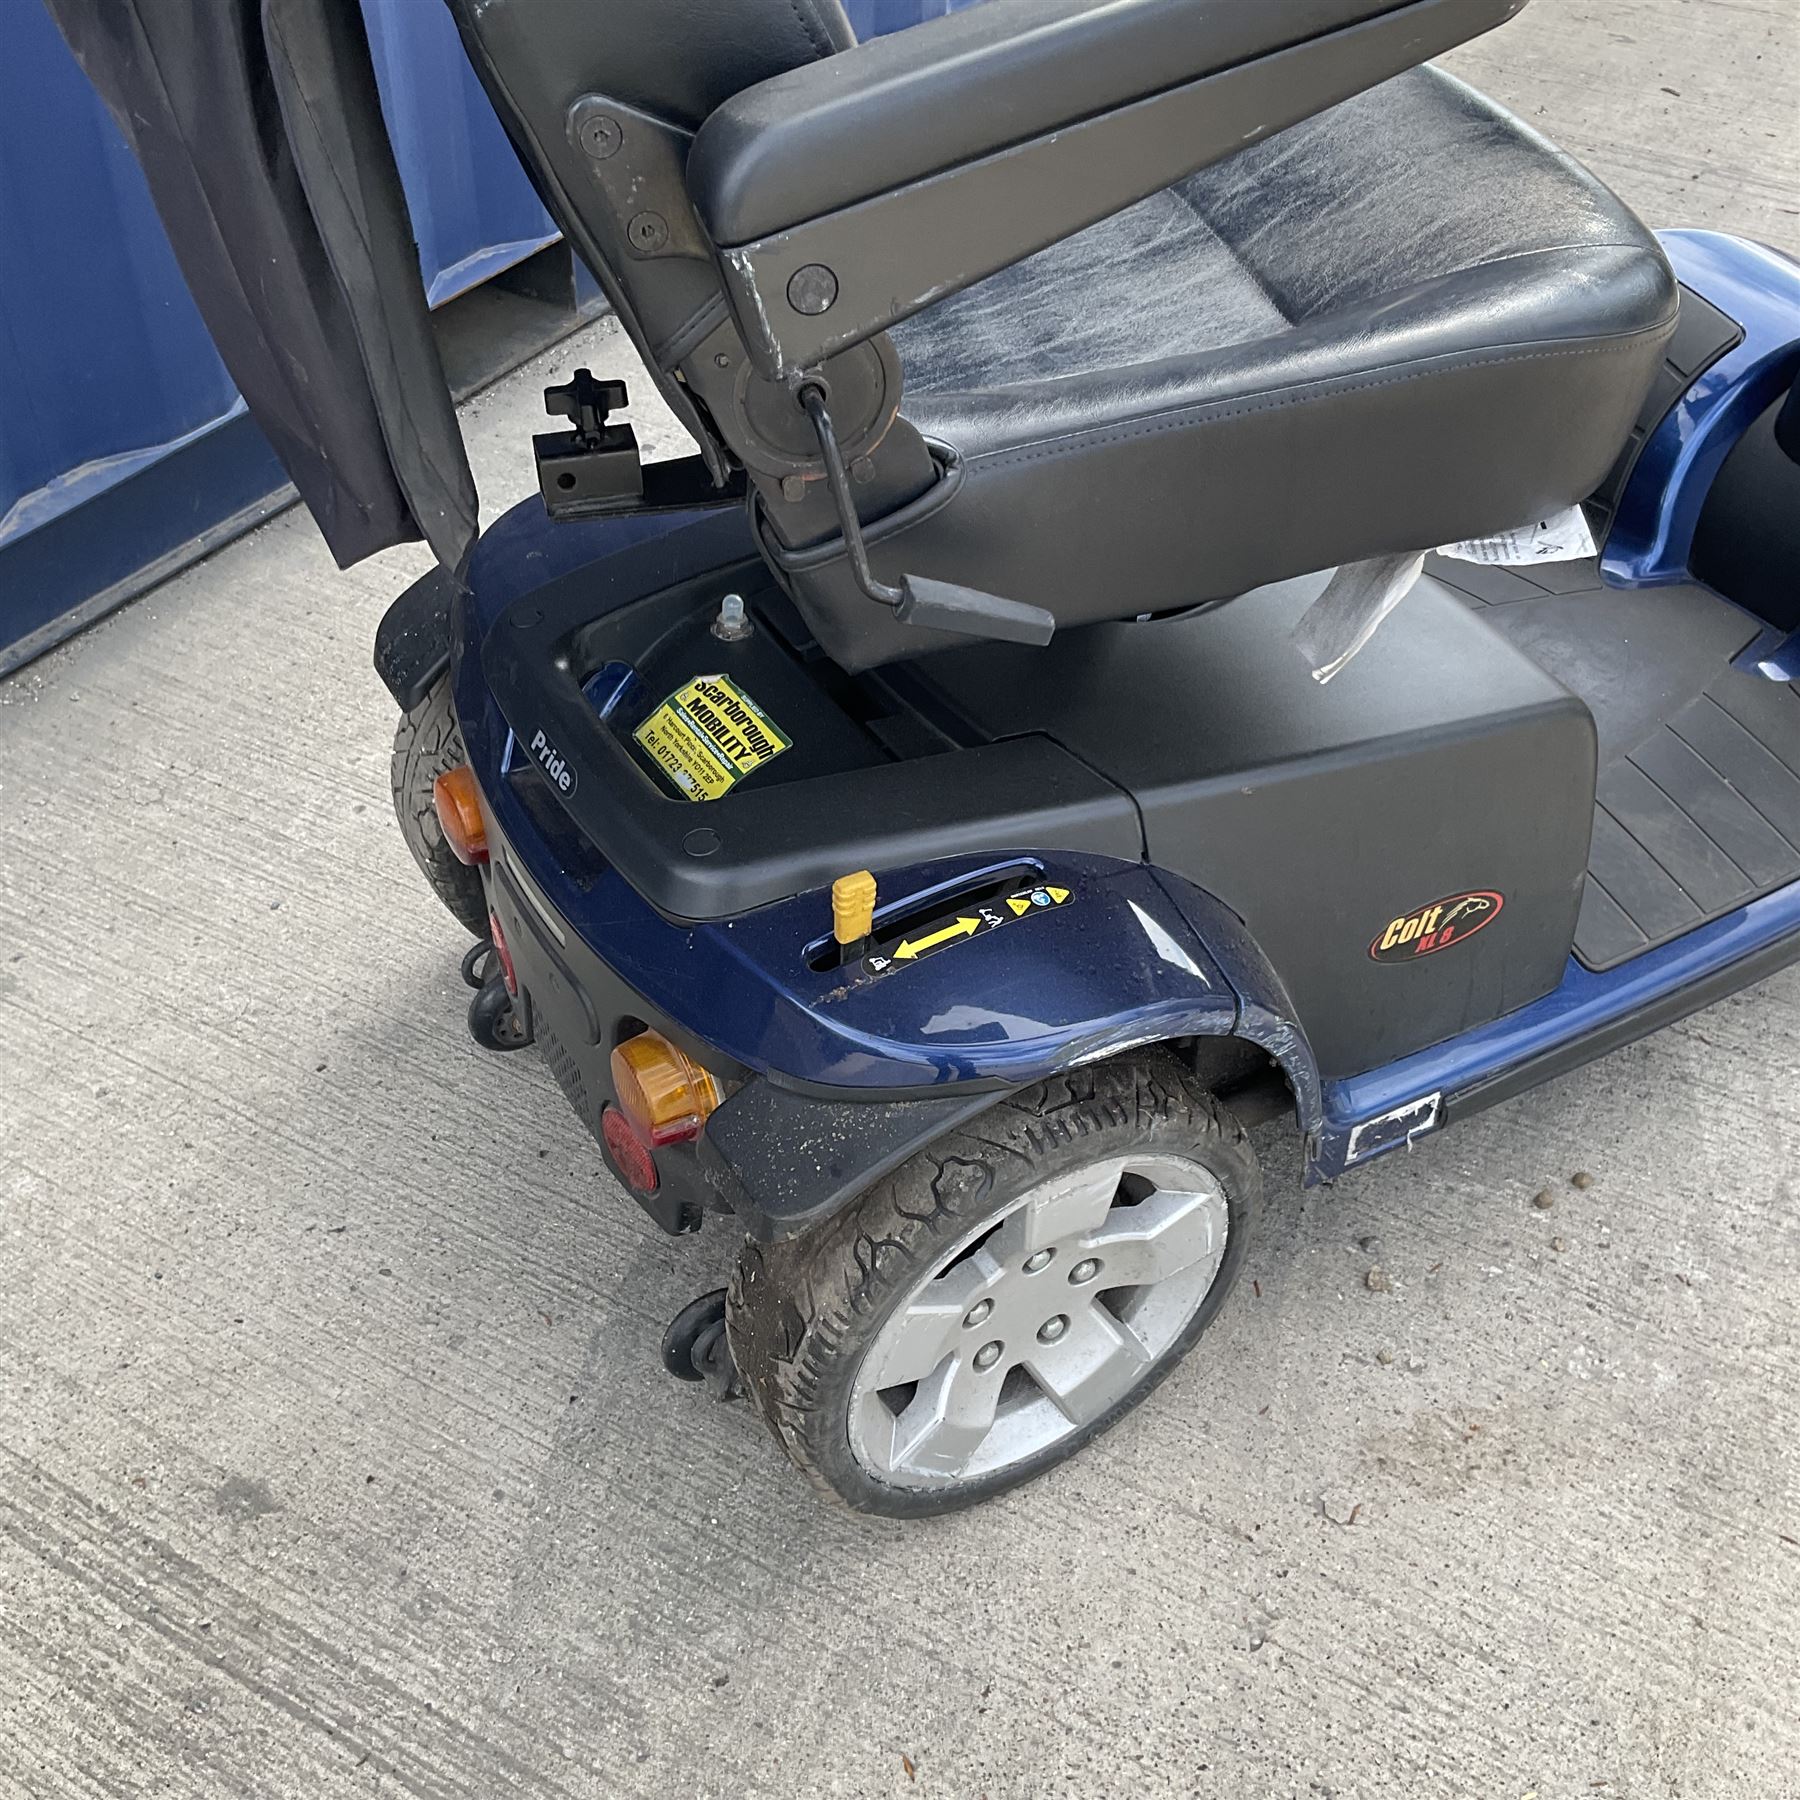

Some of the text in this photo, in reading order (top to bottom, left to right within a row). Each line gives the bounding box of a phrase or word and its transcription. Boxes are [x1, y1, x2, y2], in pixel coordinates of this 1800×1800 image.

[660, 725, 674, 741] North
[686, 697, 752, 762] MOBILITY
[694, 681, 776, 760] Scarborough
[531, 729, 571, 791] Pride
[644, 729, 660, 749] Tel:
[657, 745, 683, 772] 01723
[667, 717, 686, 739] Harcourt
[697, 751, 725, 783] Scarborough
[1380, 906, 1443, 950] Colt
[1440, 926, 1455, 943] 8
